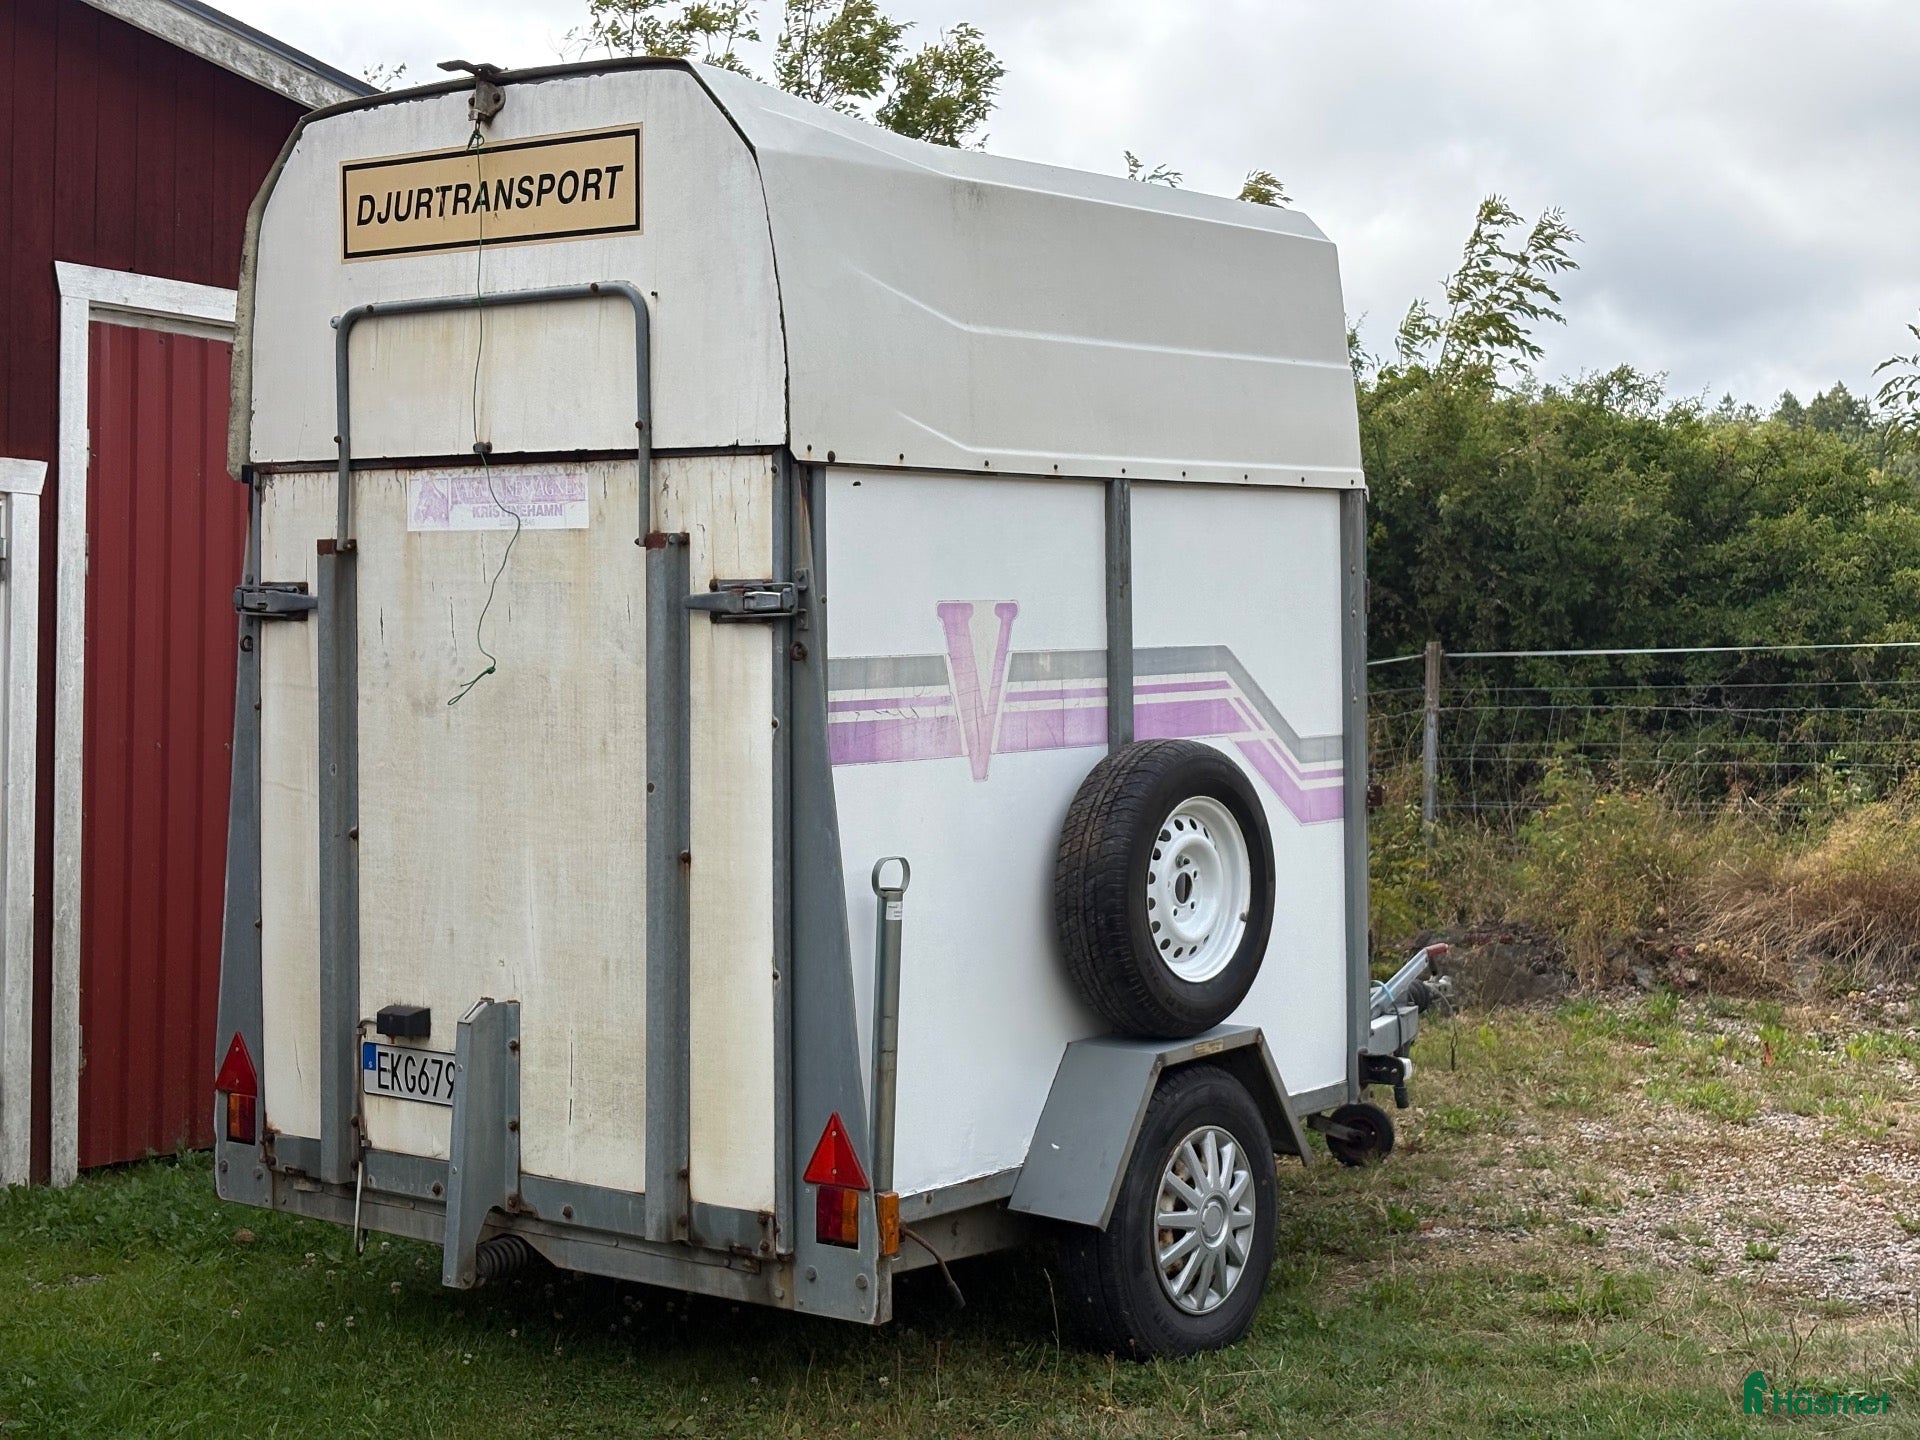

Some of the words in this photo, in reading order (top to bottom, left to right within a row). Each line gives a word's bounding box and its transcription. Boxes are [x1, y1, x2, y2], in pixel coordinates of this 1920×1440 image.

[357, 165, 624, 226] DJURTRANSPORT
[472, 503, 563, 519] KRISTINEHAMN
[377, 1051, 456, 1099] EKG679
